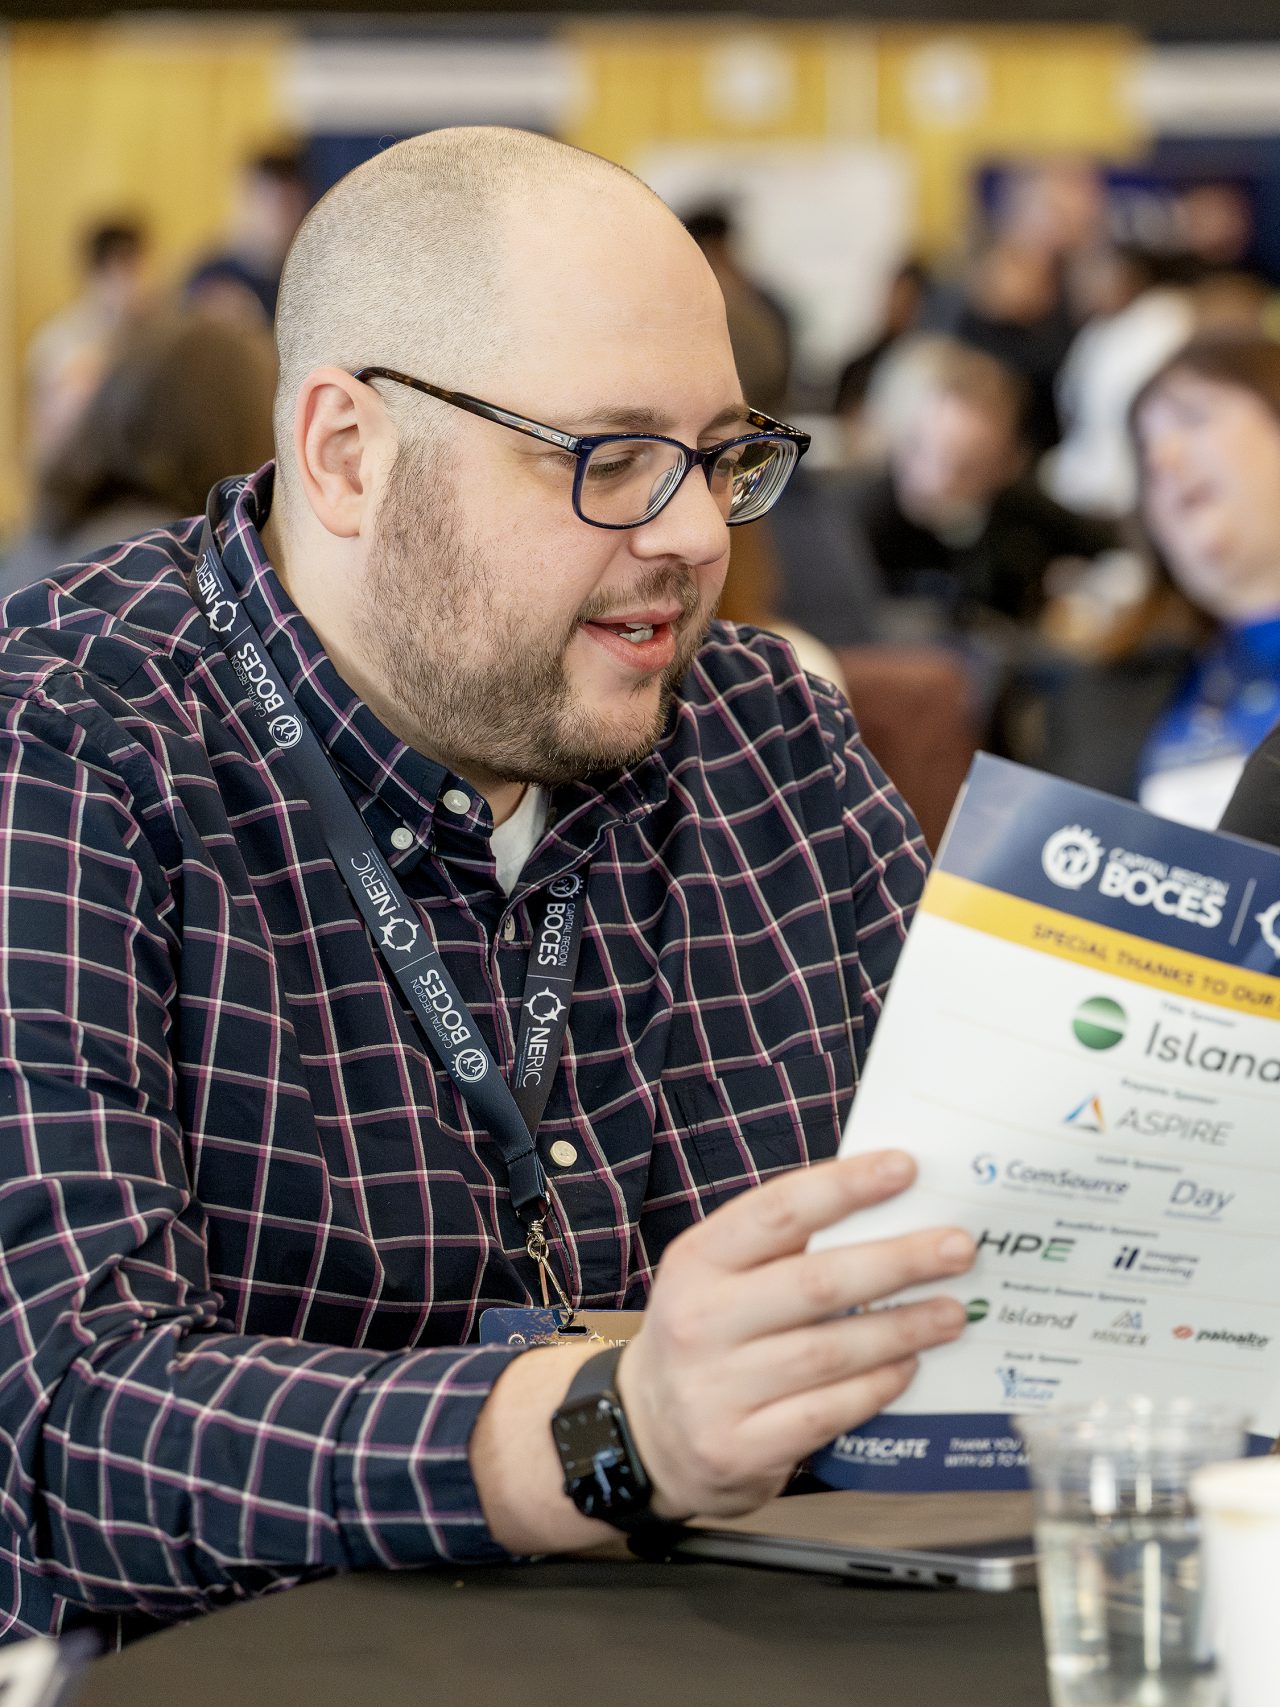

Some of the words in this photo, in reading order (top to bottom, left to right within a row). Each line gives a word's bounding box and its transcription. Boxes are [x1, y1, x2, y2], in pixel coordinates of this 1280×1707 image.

[195, 553, 221, 605] NERIC
[230, 654, 248, 687] REGION
[236, 642, 285, 713] BOCES
[246, 683, 267, 718] CAPITAL
[351, 852, 398, 917] NERIC
[1098, 862, 1228, 928] BOCES
[537, 902, 566, 967] BOCES
[562, 902, 576, 934] CAPITAL
[557, 933, 572, 967] REGION
[1033, 923, 1108, 962] SPECIAL
[1116, 949, 1194, 987] THANKS
[1202, 975, 1229, 996] TO
[1232, 983, 1275, 1006] OUR
[410, 979, 434, 1015] REGION
[418, 967, 472, 1045] BOCES
[430, 1010, 453, 1049] CAPITAL
[522, 1026, 549, 1088] NERIC
[1113, 1107, 1236, 1148] ASPIRE
[1005, 1159, 1131, 1197] ComSource
[1170, 1178, 1236, 1217] Day
[977, 1229, 1077, 1263] HPE
[998, 1303, 1079, 1330] Island
[833, 1433, 931, 1460] NYSCATE
[950, 1437, 992, 1452] THANK
